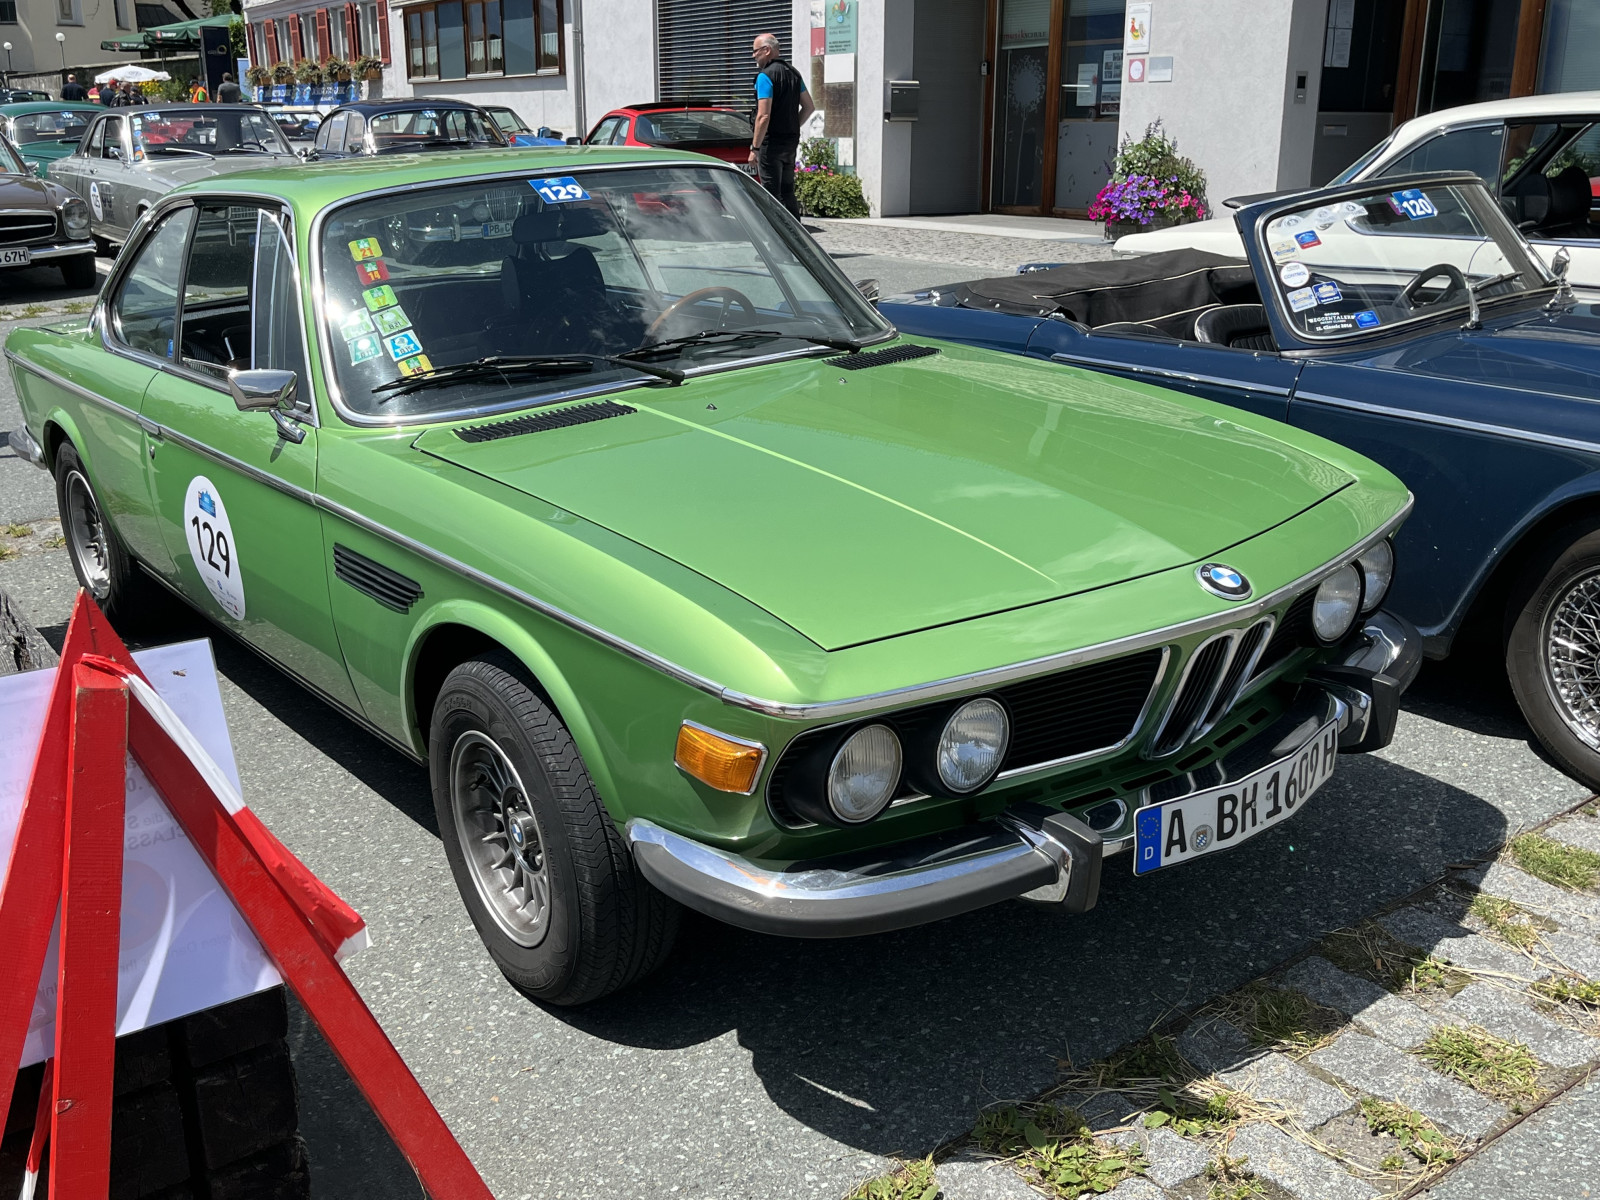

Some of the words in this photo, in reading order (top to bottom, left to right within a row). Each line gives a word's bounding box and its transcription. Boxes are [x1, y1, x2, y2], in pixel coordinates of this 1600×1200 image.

[539, 184, 582, 201] 129
[1402, 198, 1432, 217] 120
[5, 250, 27, 263] 67H
[360, 247, 374, 258] 21
[368, 270, 381, 281] 14
[191, 515, 231, 579] 129
[1164, 809, 1187, 858] A
[1145, 846, 1154, 861] D
